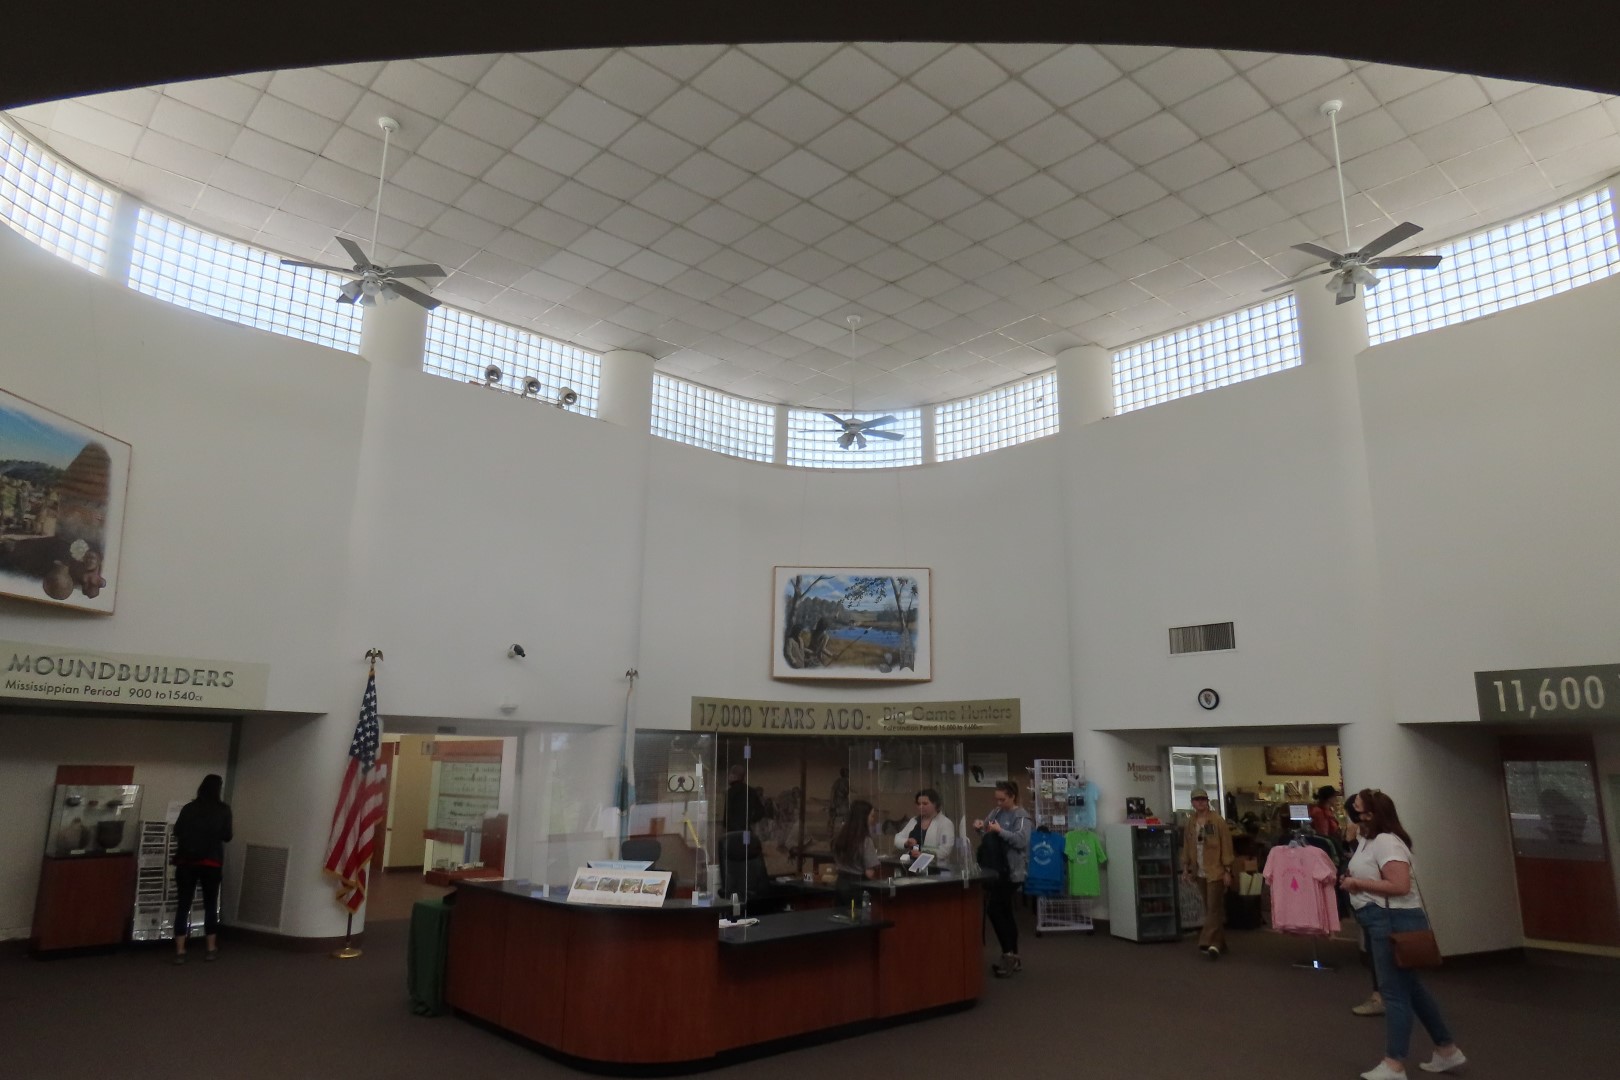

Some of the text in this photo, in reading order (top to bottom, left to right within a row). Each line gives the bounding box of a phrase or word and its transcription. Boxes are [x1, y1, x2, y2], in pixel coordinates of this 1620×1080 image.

[7, 653, 234, 687] MOUNDBUILDERS
[5, 680, 79, 695] Mississippian
[84, 685, 120, 697] Period
[129, 687, 152, 698] 900
[155, 690, 166, 699] to
[1493, 675, 1605, 719] 11,600
[699, 703, 752, 732] 17,000
[759, 706, 815, 729] YEARS
[883, 704, 1012, 725] Big Game Hunters
[1127, 762, 1162, 772] Museum
[1133, 772, 1155, 782] Store
